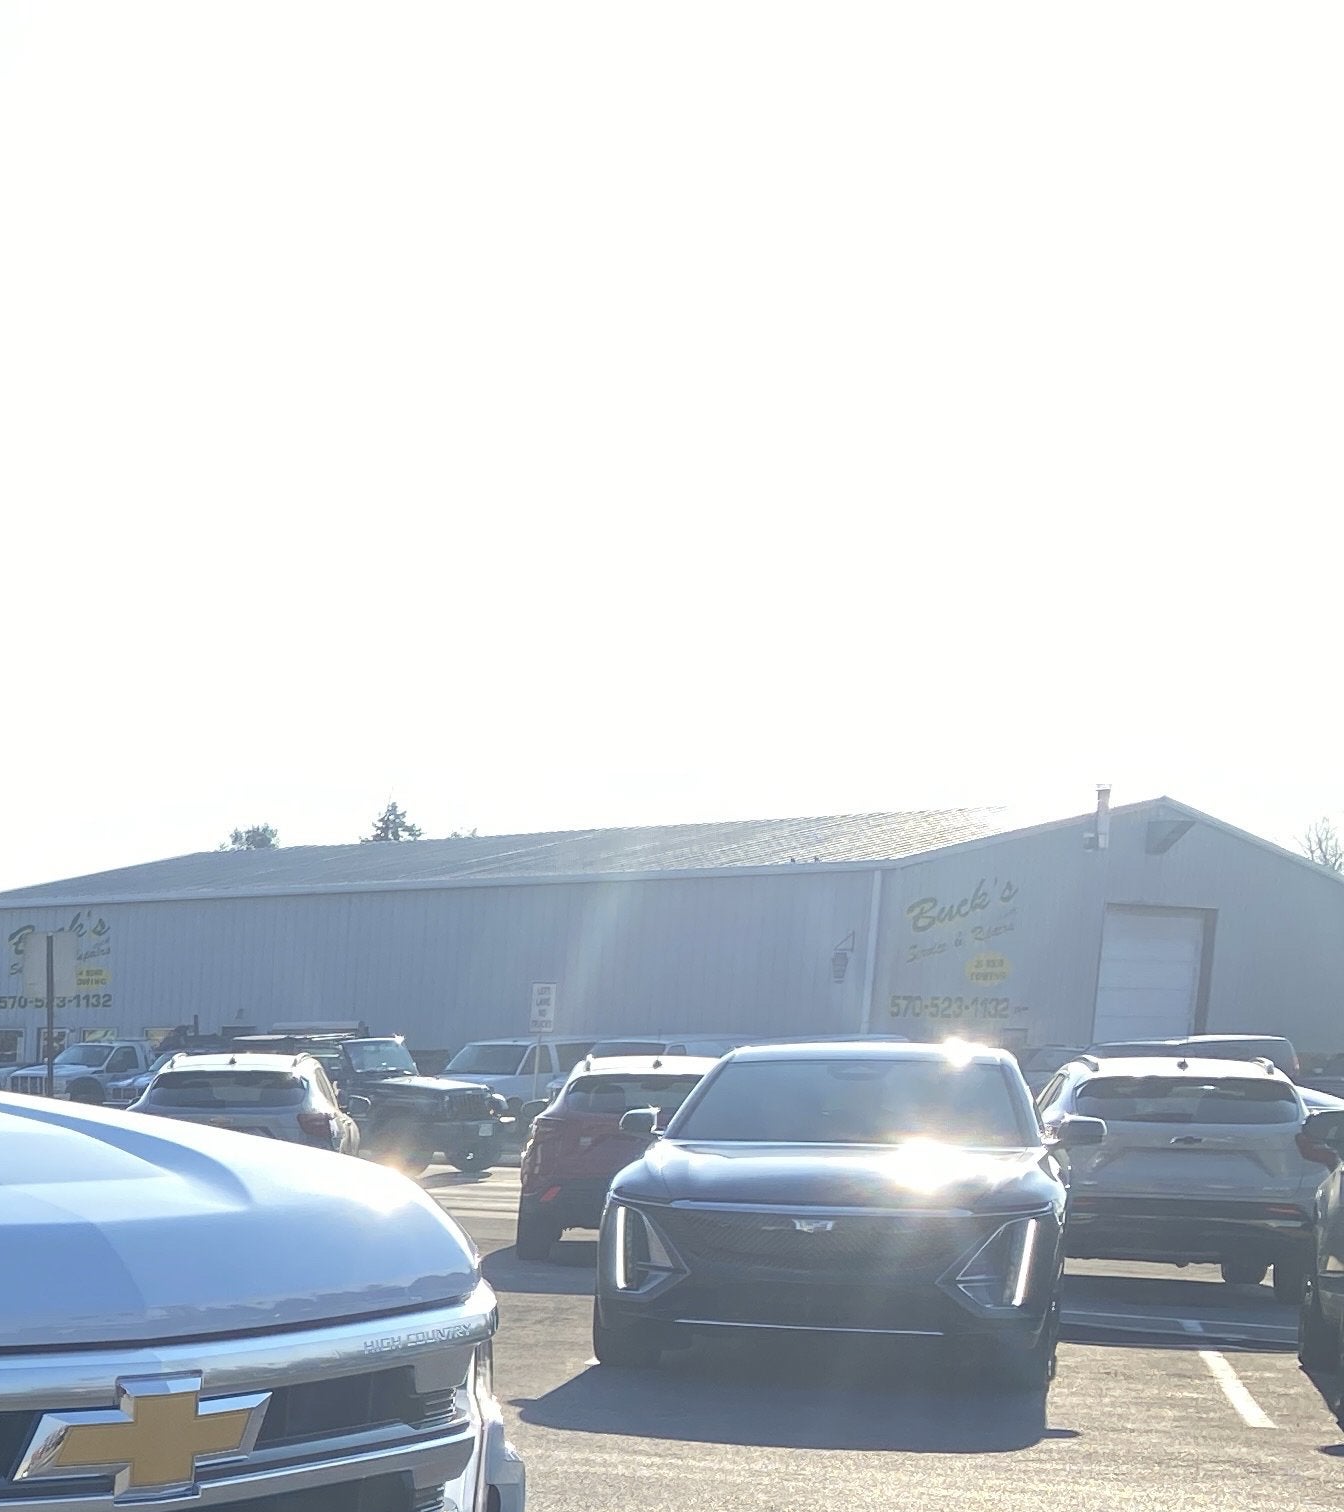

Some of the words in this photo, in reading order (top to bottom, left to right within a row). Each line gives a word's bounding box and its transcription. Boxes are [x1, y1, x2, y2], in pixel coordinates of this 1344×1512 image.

[906, 878, 1018, 932] Buck's
[363, 1335, 402, 1355] HIGH
[406, 1322, 472, 1347] COUNTRY
